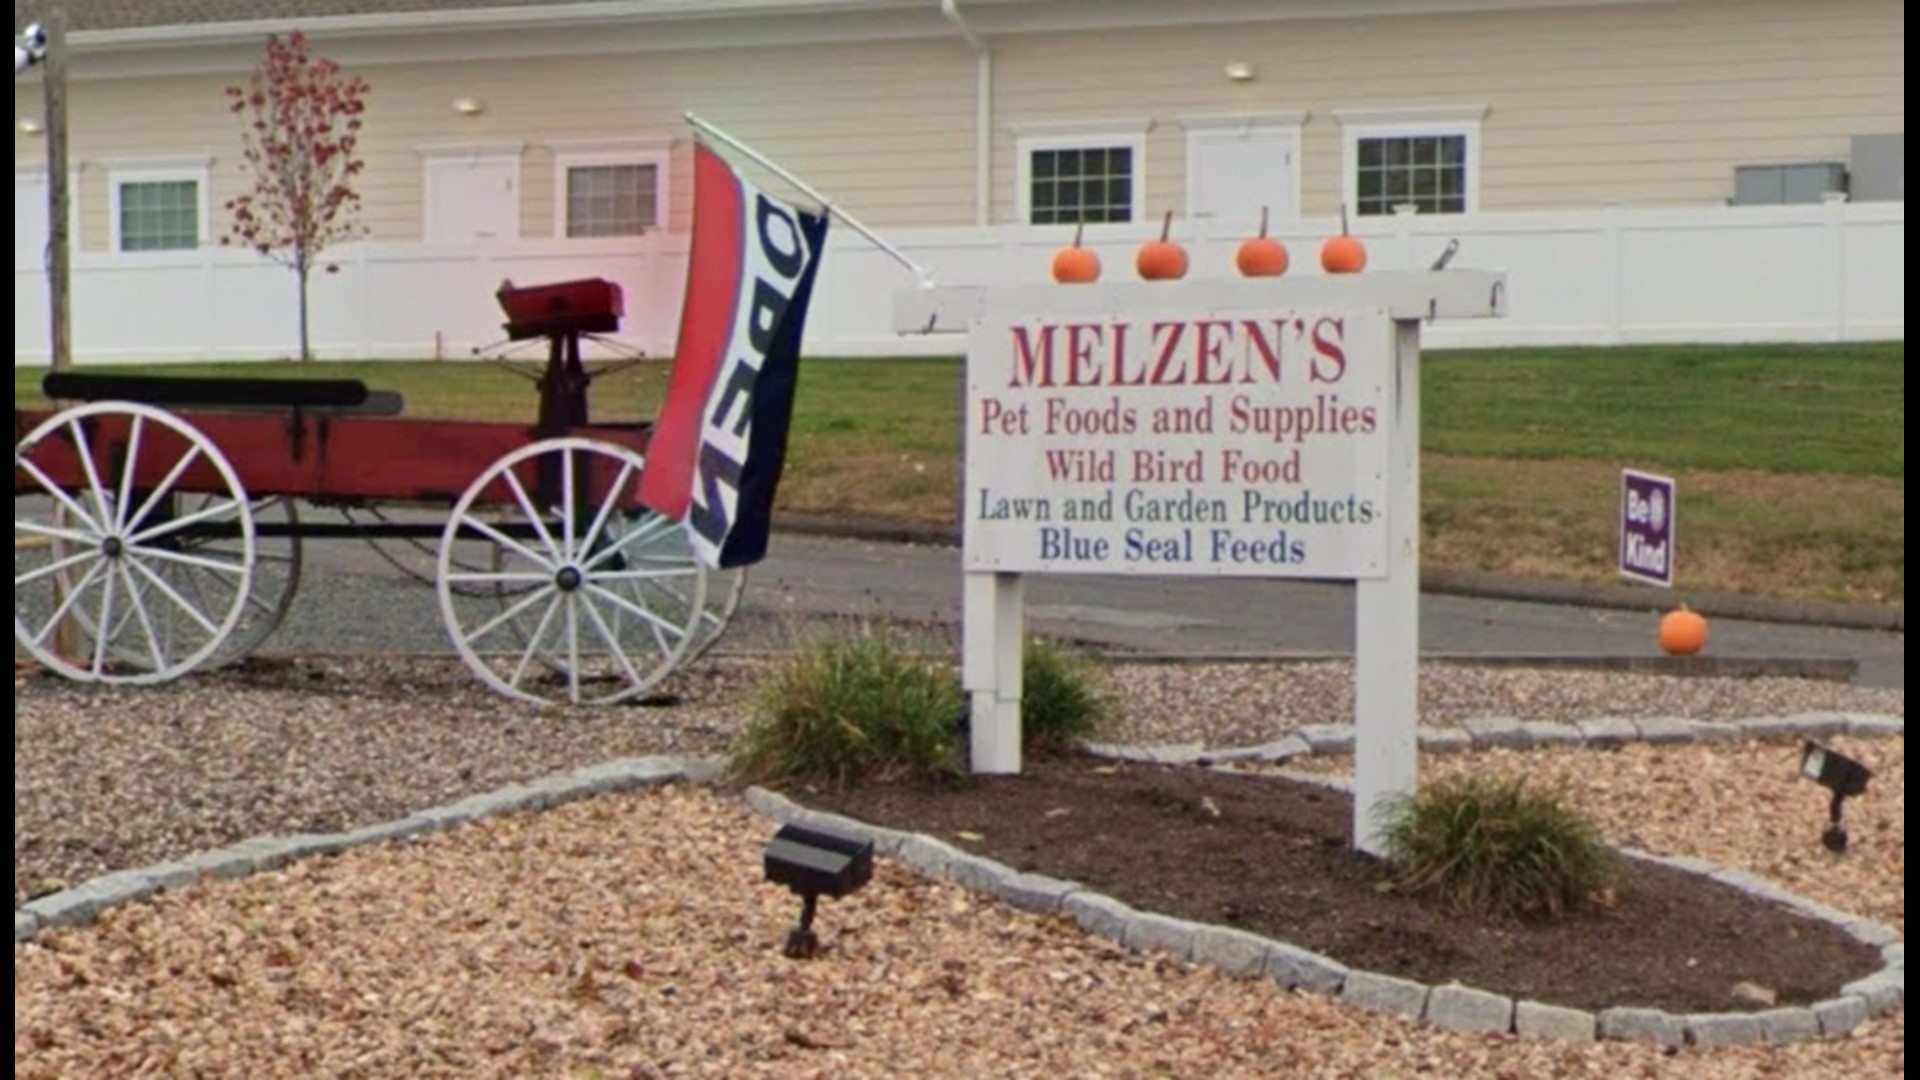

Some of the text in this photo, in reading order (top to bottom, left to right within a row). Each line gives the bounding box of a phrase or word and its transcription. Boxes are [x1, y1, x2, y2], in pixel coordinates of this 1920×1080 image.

[1008, 316, 1347, 387] MELZEN'S
[980, 396, 1377, 442] Pet Foods and Supplies
[1046, 451, 1302, 483] Wild Bird Food
[978, 488, 1374, 524] Lawn and Garden Products
[1627, 488, 1650, 523] Be
[1040, 528, 1306, 564] Blue Seal Feeds
[1626, 531, 1666, 574] Kind
